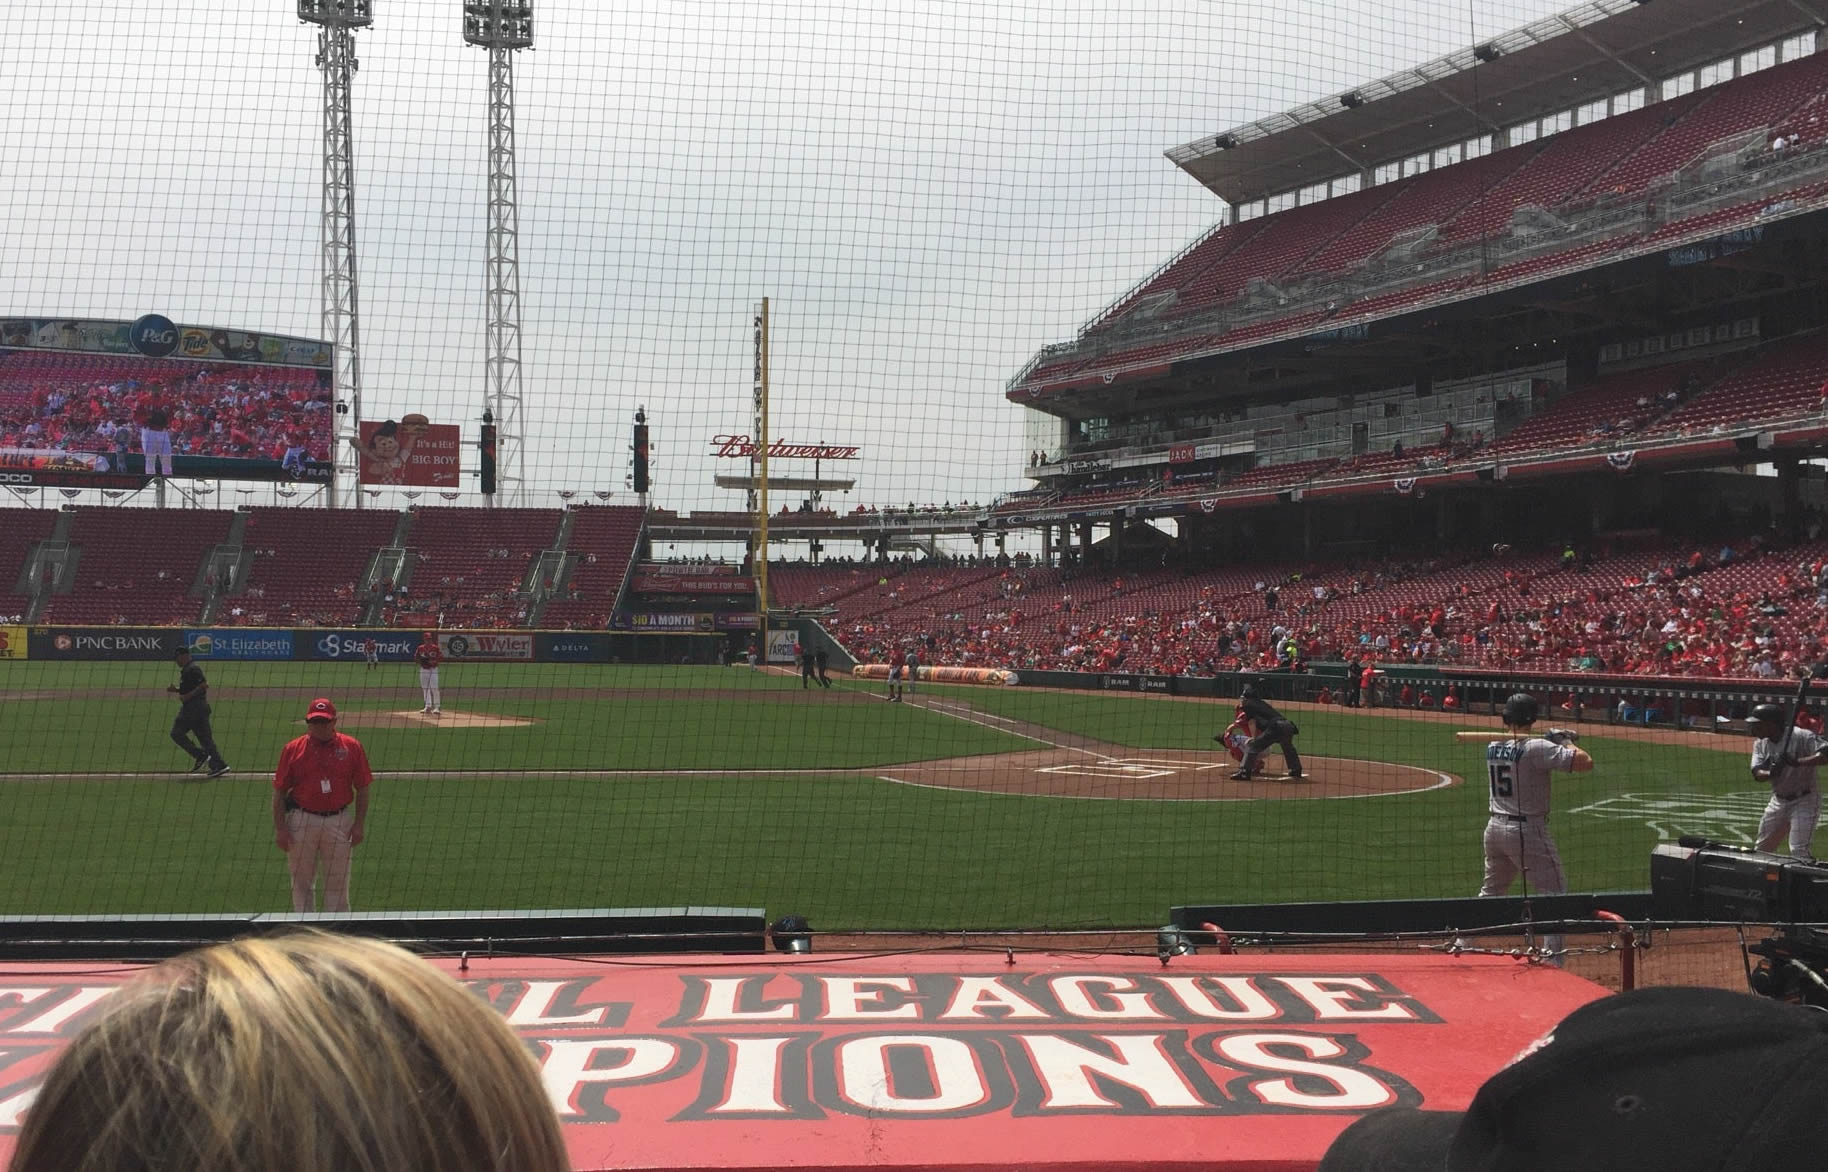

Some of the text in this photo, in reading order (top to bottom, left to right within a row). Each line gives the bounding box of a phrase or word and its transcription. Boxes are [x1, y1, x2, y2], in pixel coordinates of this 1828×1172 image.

[141, 328, 174, 344] P&G
[183, 335, 208, 351] Tide
[712, 434, 857, 458] Budweiser
[412, 455, 456, 465] BIG BOY
[1170, 449, 1193, 461] JACK
[1071, 462, 1111, 474] handlebar
[682, 581, 697, 589] THIS
[698, 581, 717, 589] BUD'S
[719, 581, 732, 589] FOR
[631, 615, 695, 626] $10 A MONTH
[75, 636, 162, 650] PNC BANK
[231, 638, 290, 650] Elizabeth
[343, 639, 411, 654] Stamark
[475, 636, 529, 651] Wyler
[1490, 765, 1512, 798] 15
[688, 975, 1425, 1022] LEAGUE
